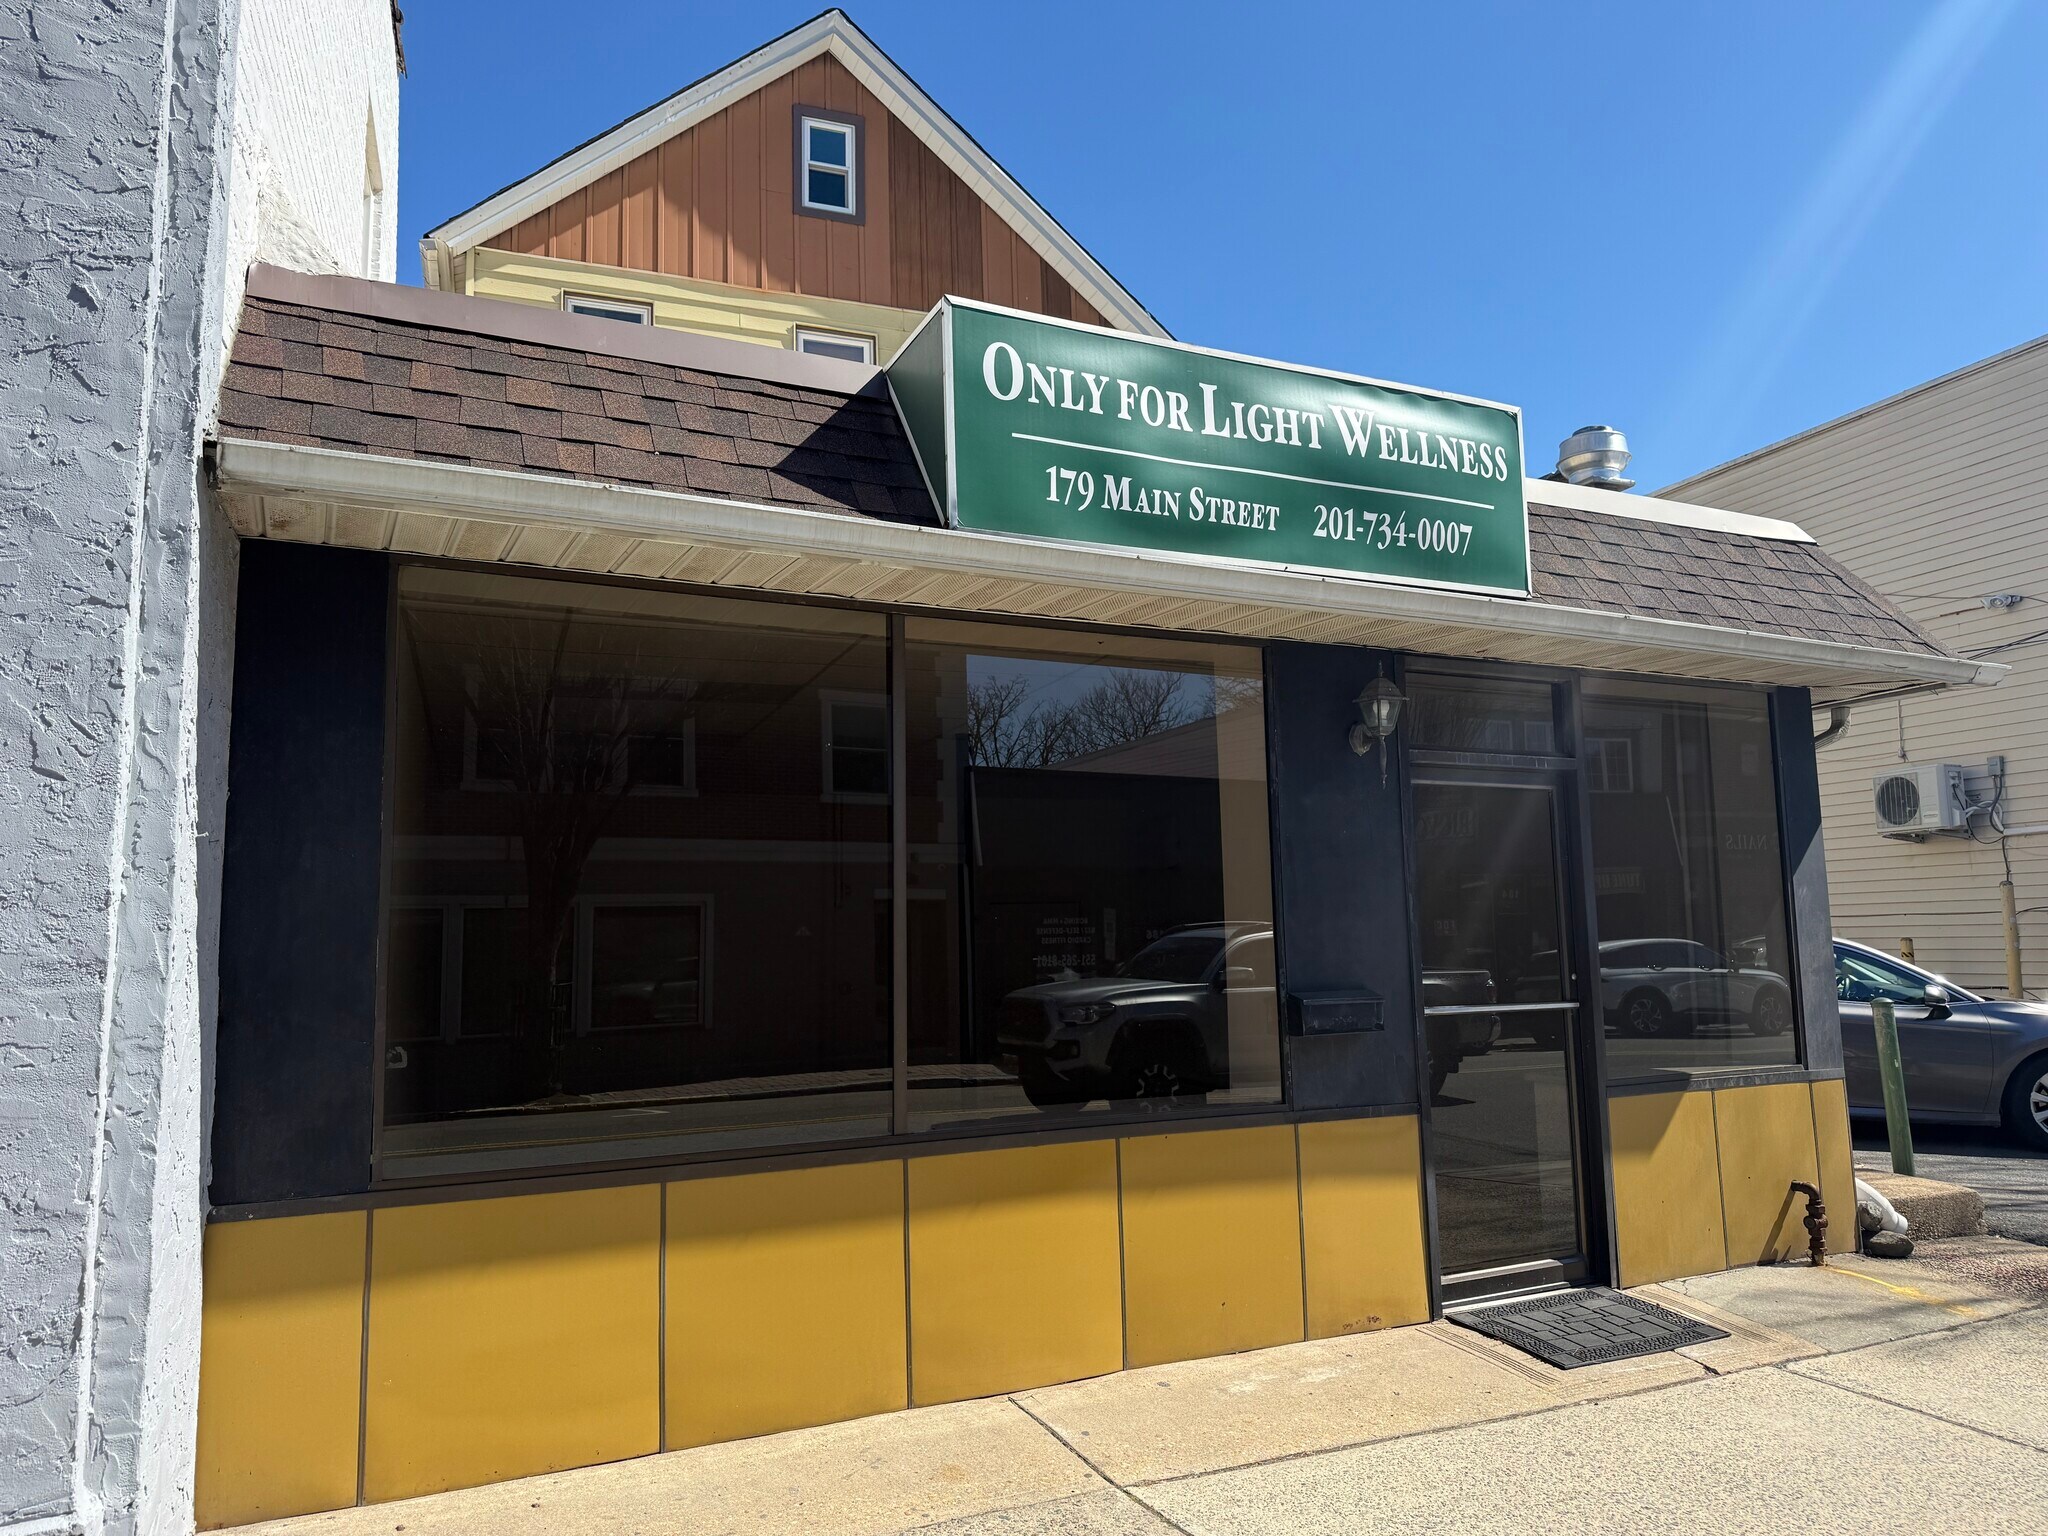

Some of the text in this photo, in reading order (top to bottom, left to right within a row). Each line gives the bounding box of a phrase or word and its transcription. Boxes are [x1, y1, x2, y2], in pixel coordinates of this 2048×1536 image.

[983, 341, 1508, 482] ONLY FOR LIGHT WELLNESS
[1045, 465, 1280, 531] 179 MAIN STREET
[1313, 503, 1474, 556] 201-734-0007
